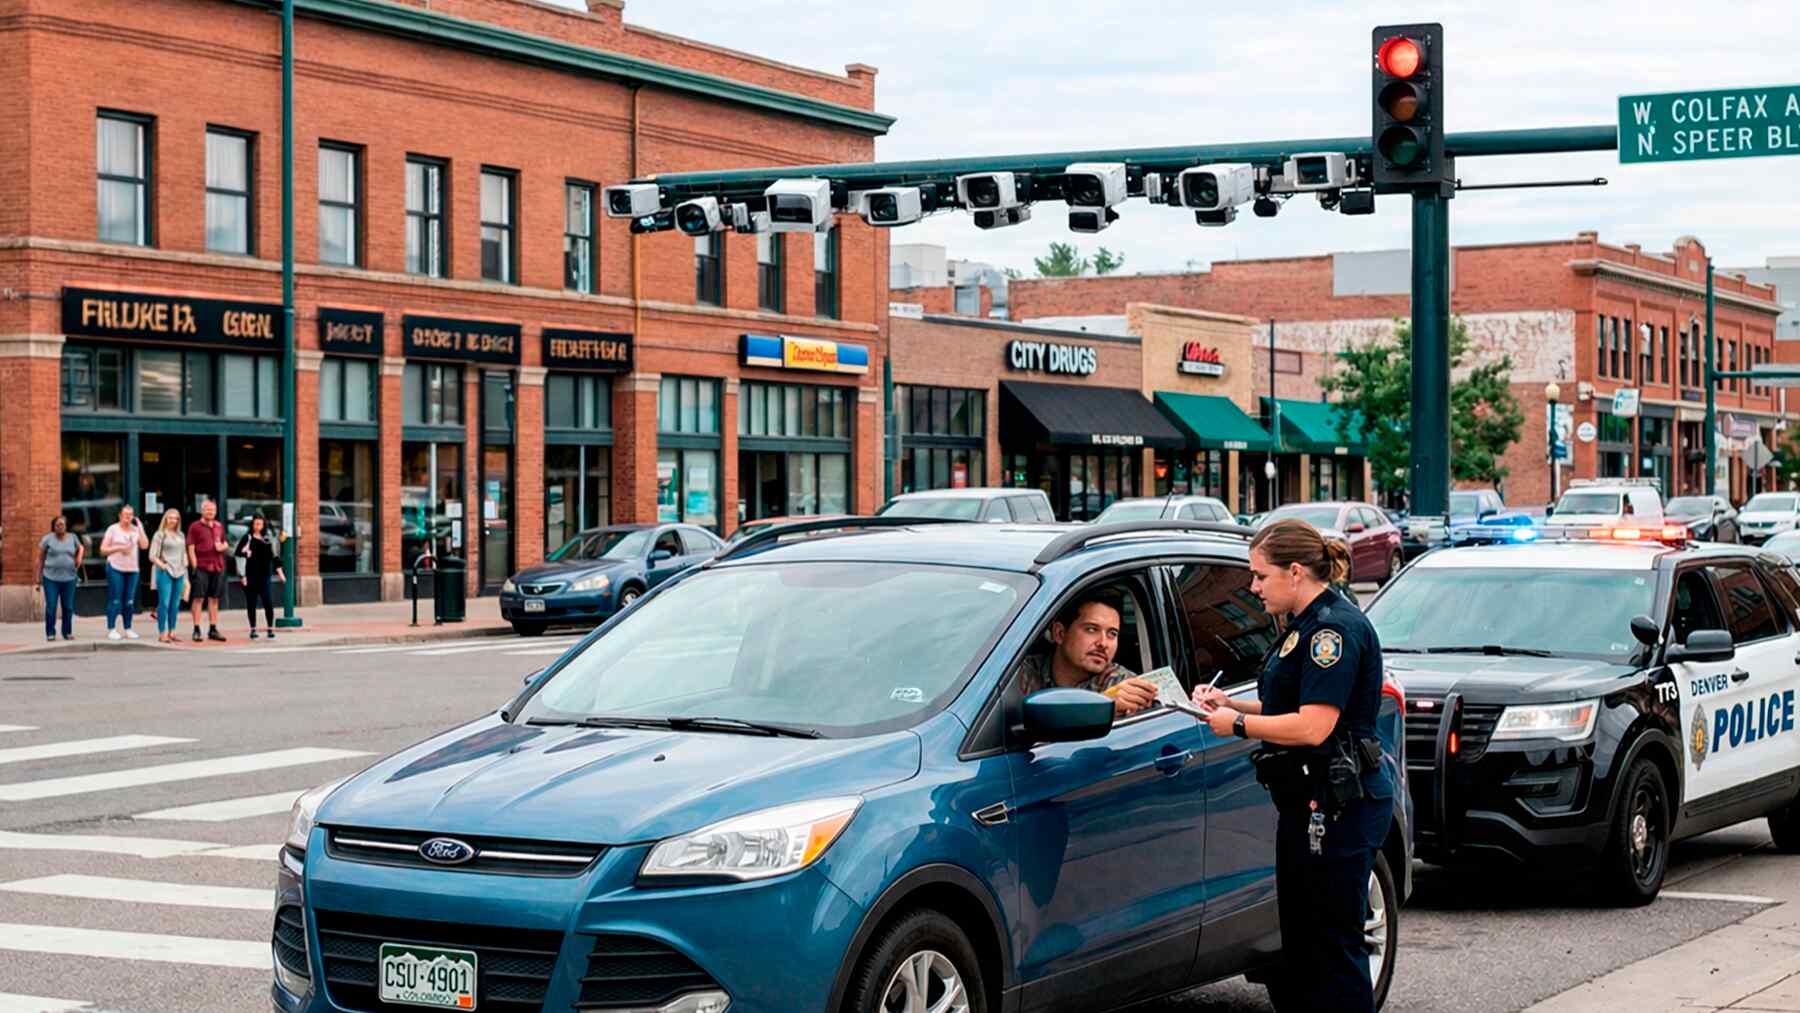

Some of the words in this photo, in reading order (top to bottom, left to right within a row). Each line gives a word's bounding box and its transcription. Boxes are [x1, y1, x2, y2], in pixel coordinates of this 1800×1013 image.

[1671, 94, 1768, 124] COLFAX
[1638, 132, 1659, 156] N.
[1672, 127, 1753, 154] SPEER
[1767, 124, 1800, 149] BL
[1011, 340, 1046, 369] CITY
[1049, 344, 1097, 374] DRUGS
[1691, 674, 1728, 696] DENVER
[1712, 690, 1794, 753] POLICE
[428, 841, 460, 858] Ford
